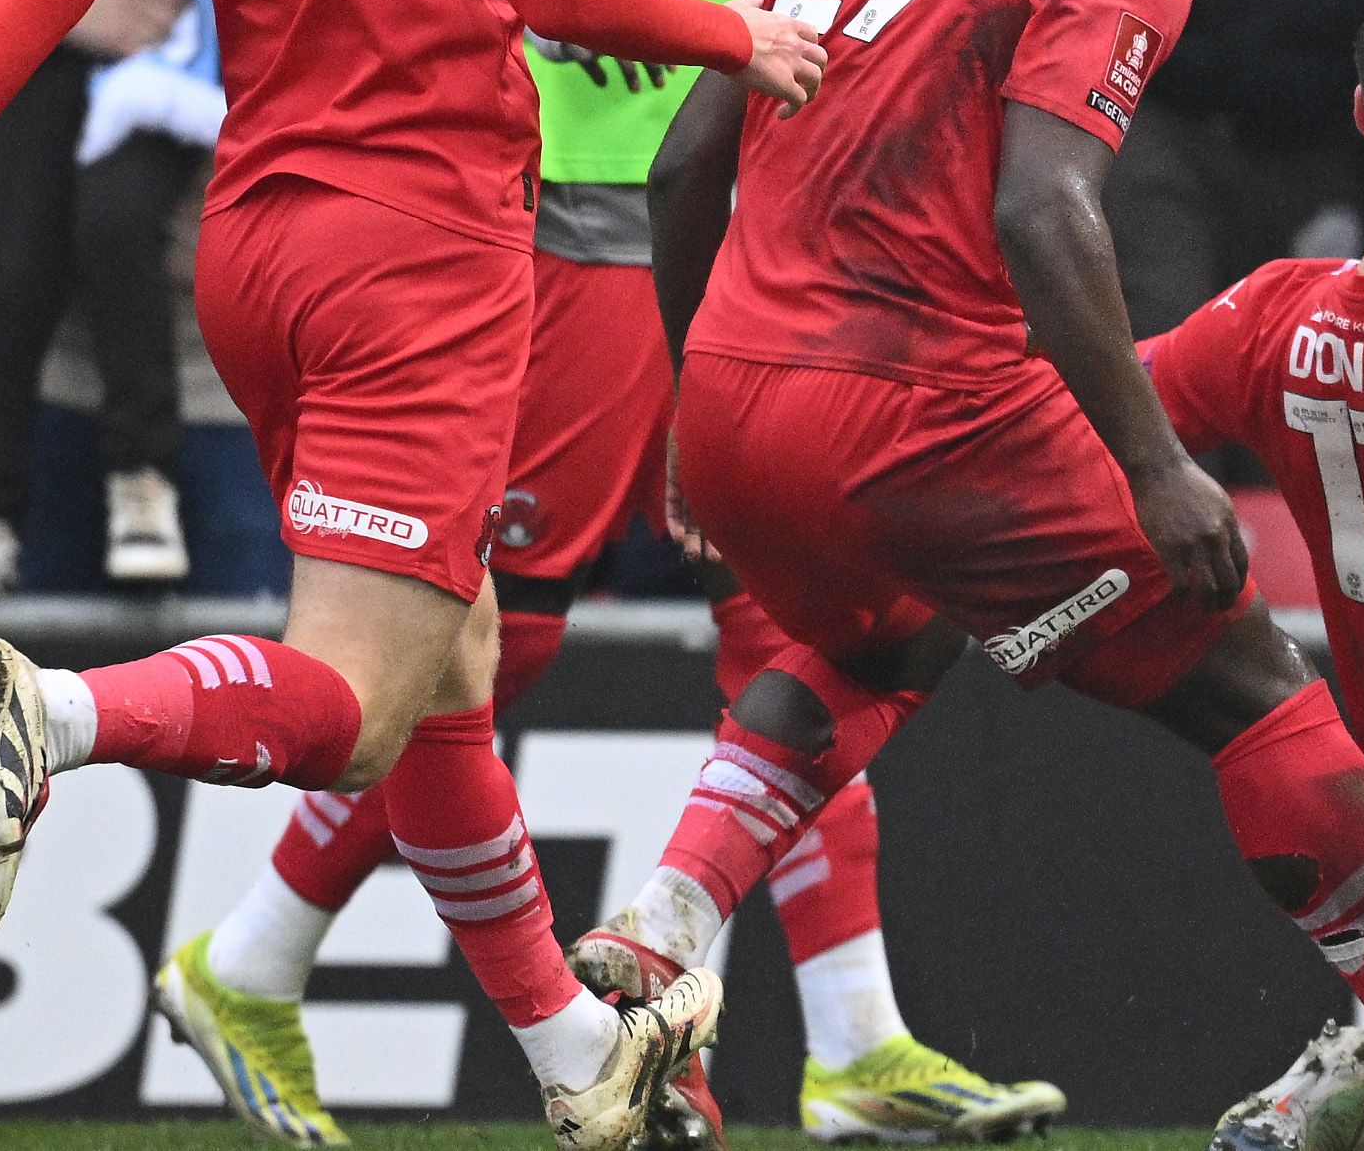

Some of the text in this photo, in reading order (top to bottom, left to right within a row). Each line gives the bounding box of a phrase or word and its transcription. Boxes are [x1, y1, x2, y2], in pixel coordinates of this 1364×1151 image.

[1110, 70, 1139, 98] FA CUP
[291, 494, 414, 541] QUATTRO
